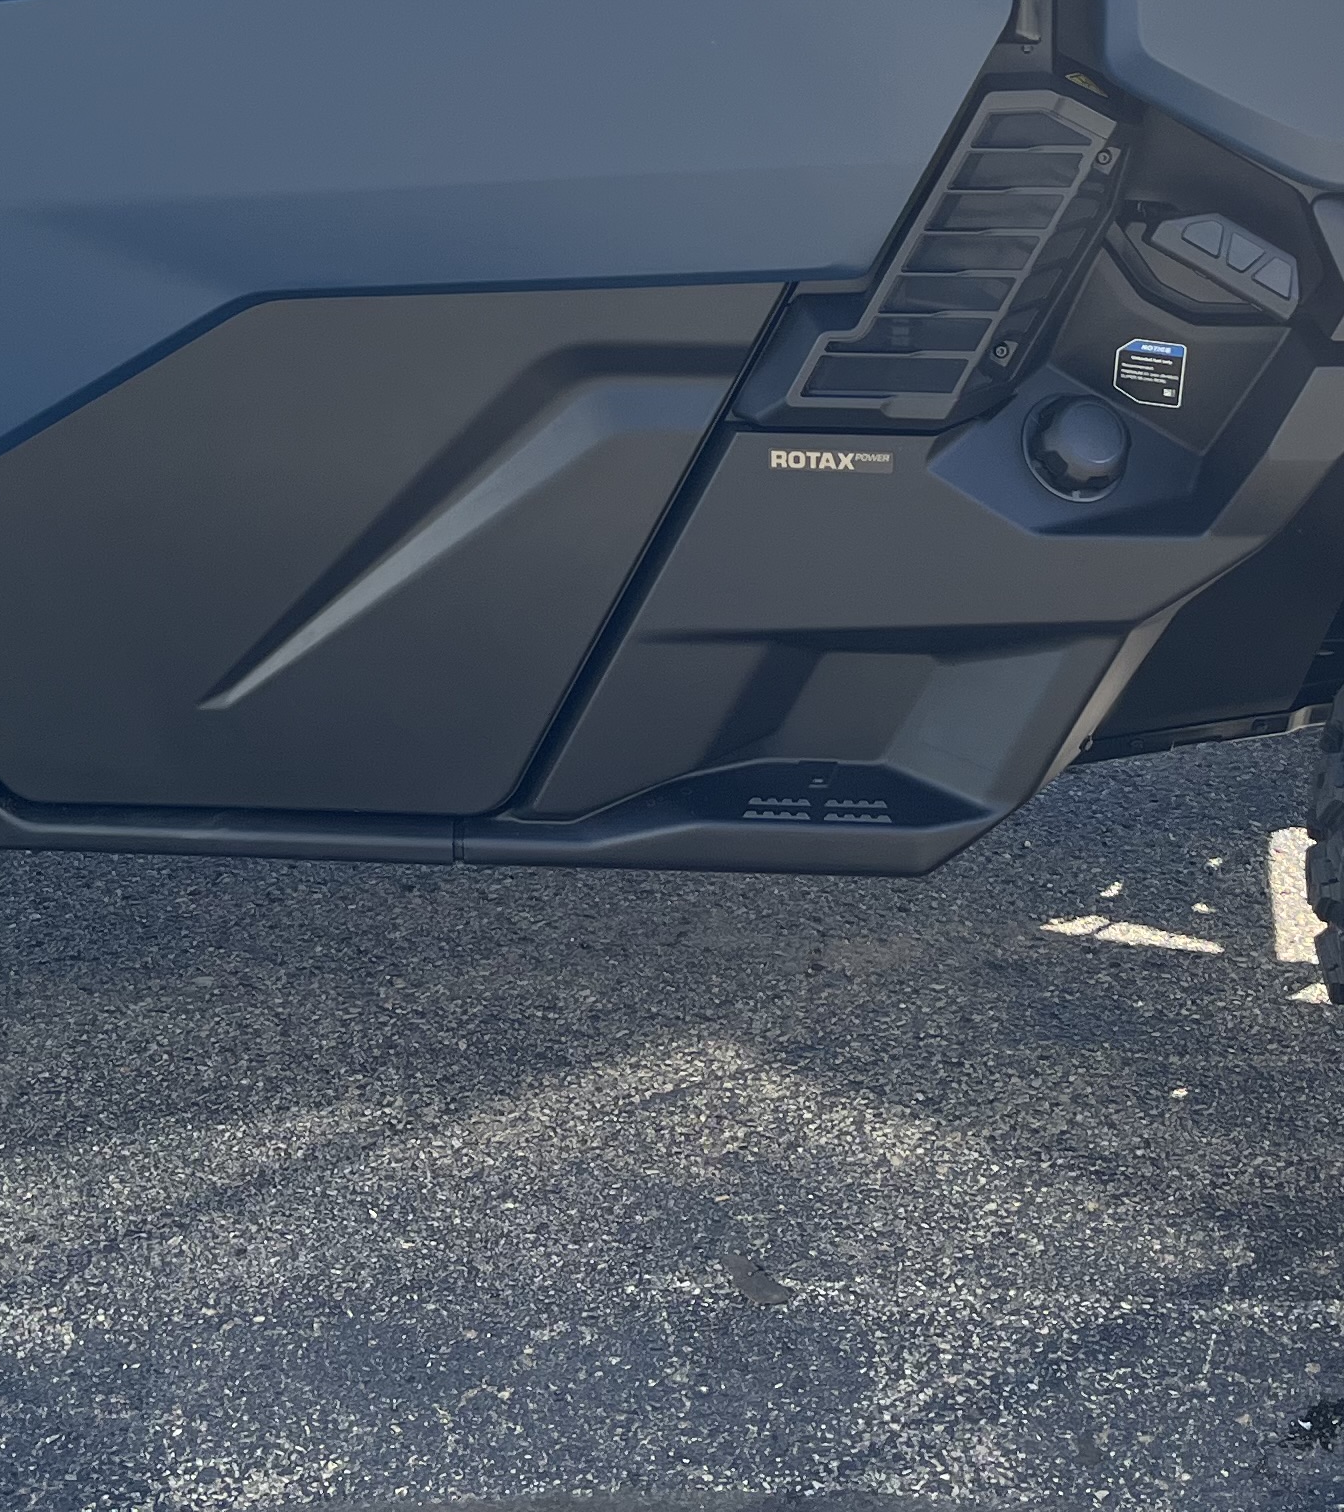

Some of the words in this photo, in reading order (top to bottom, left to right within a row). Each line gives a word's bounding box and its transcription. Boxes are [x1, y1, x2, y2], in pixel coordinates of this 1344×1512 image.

[1140, 344, 1172, 354] NOTICE
[770, 450, 855, 471] ROTAX
[855, 453, 890, 462] POWER
